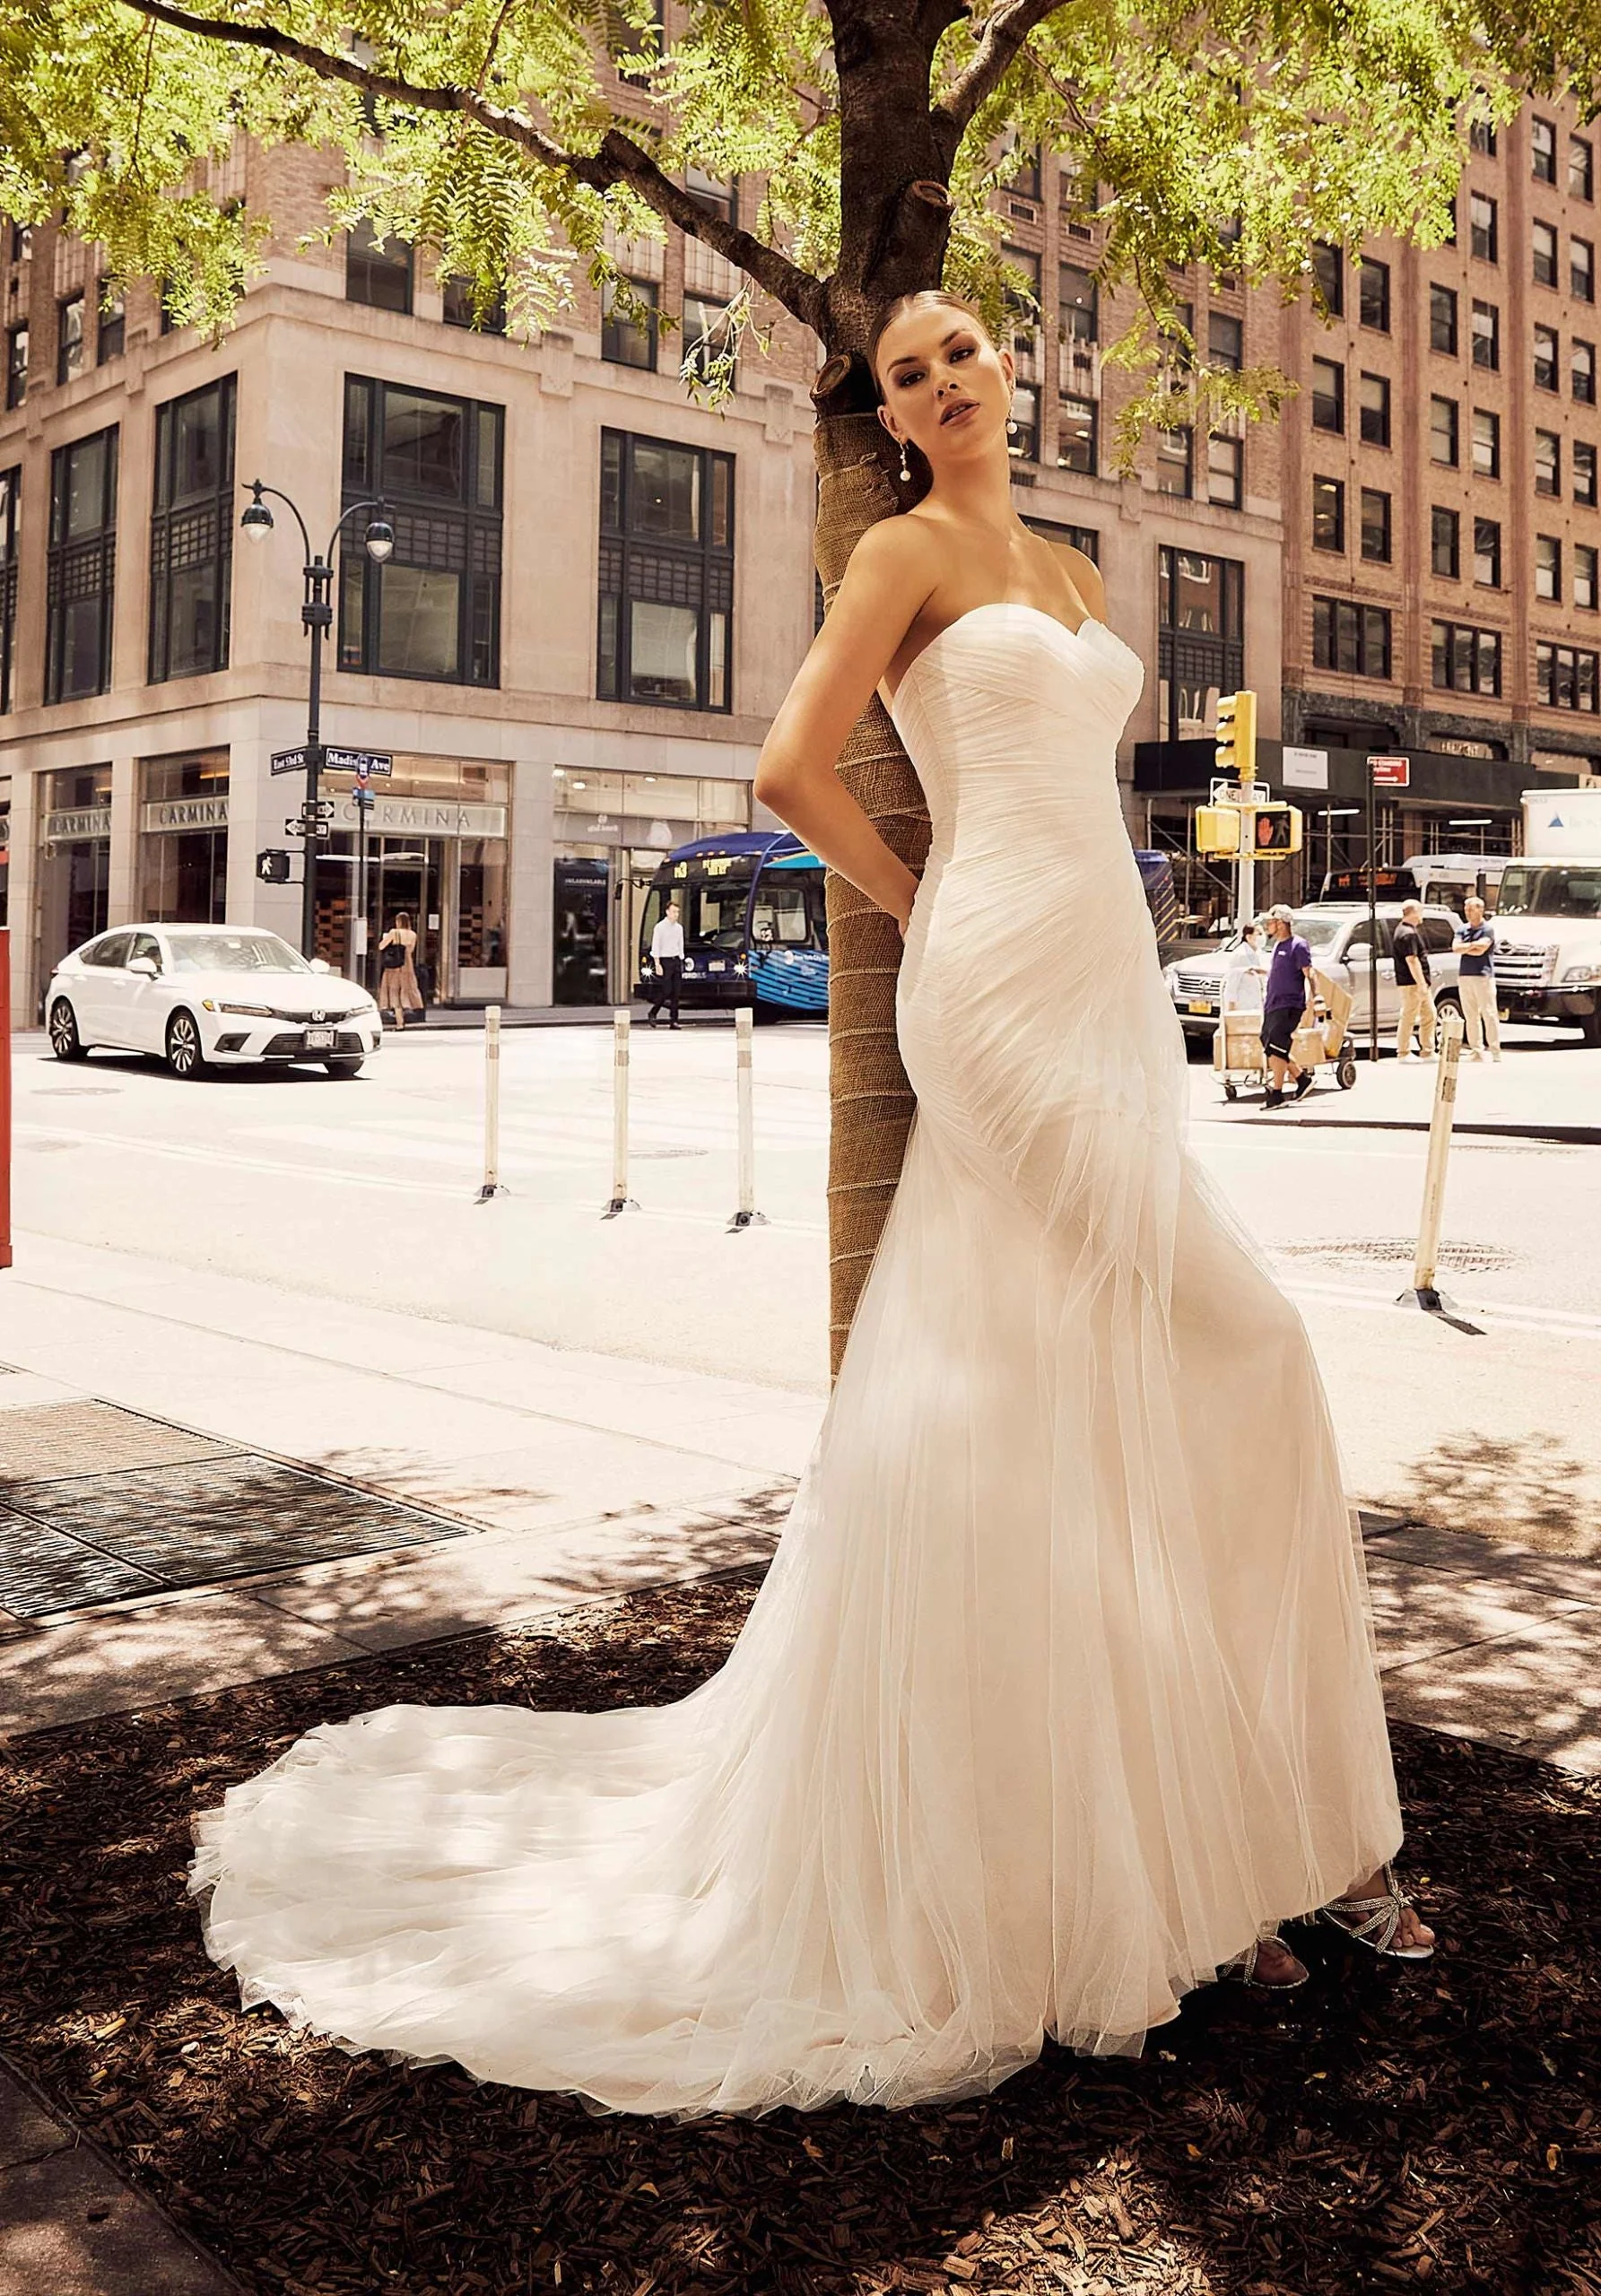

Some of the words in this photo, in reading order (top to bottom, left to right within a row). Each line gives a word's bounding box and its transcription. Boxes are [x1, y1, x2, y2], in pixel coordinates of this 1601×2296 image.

[370, 759, 389, 770] Ave
[160, 801, 228, 825] CARMINA
[343, 804, 471, 828] CRMINA
